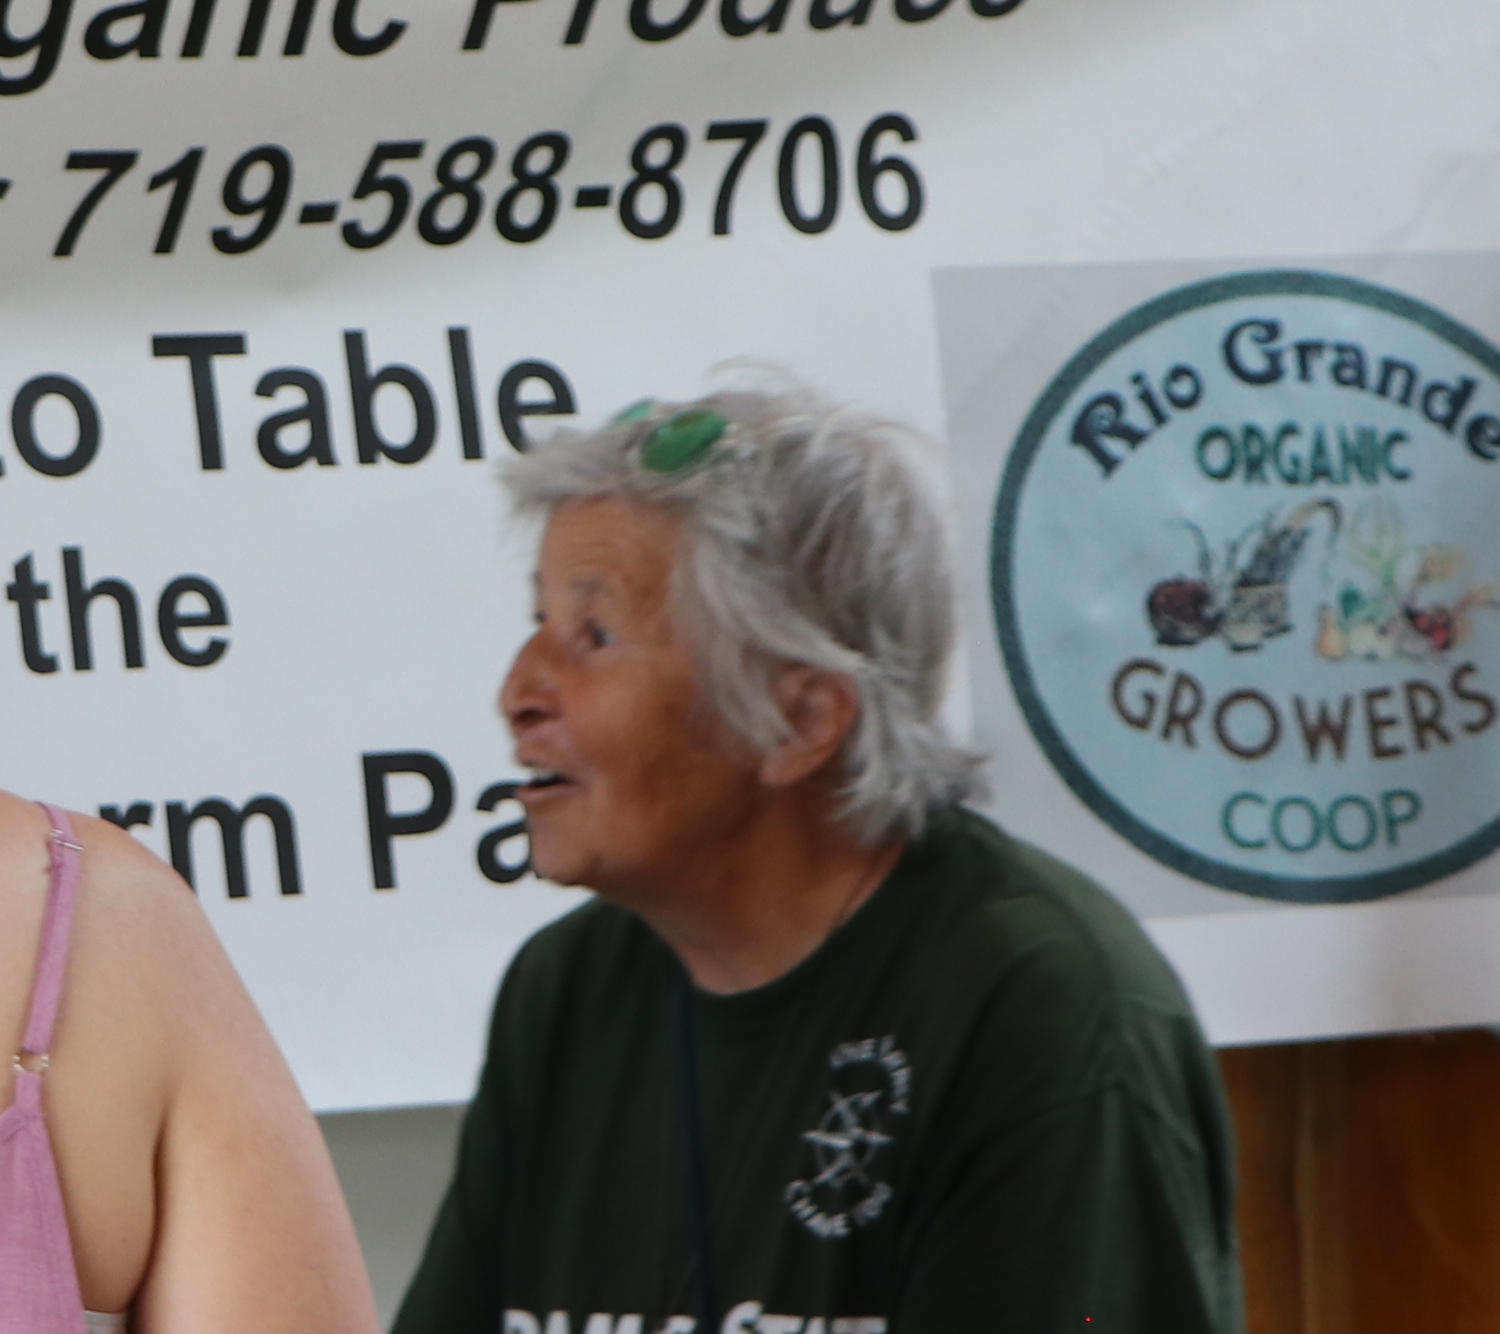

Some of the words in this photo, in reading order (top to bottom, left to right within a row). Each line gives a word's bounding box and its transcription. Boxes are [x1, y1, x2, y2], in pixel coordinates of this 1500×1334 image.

[52, 112, 924, 258] 719-588-8706
[151, 327, 577, 472] Table
[1067, 357, 1205, 481] Rio
[1195, 422, 1413, 487] ORGANIC
[5, 547, 229, 675] the
[1108, 658, 1500, 765] GROWERS
[361, 749, 531, 886] Pa
[1219, 788, 1424, 856] COOP
